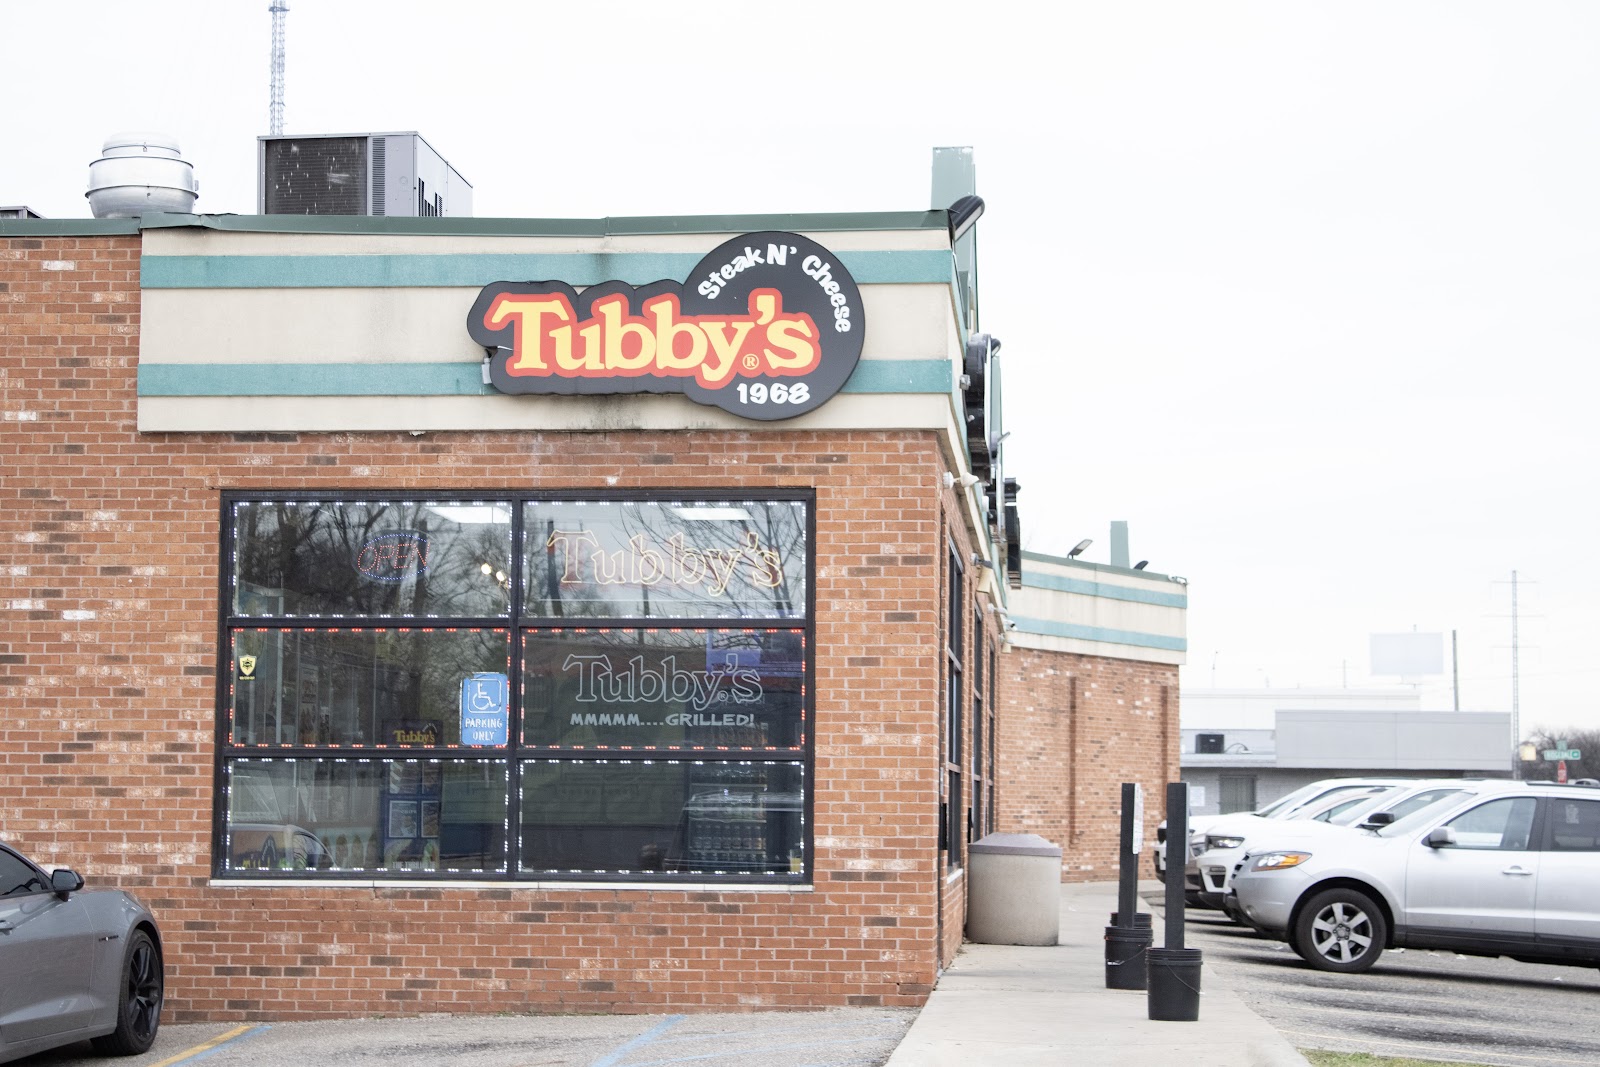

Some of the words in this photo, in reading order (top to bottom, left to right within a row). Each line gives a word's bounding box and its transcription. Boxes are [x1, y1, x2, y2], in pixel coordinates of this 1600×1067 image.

[697, 246, 765, 300] Steak
[766, 243, 797, 266] N'
[801, 254, 852, 333] Cheese
[490, 293, 816, 383] Tubby's
[736, 381, 811, 405] 1968
[357, 541, 431, 572] OPEN
[546, 529, 783, 597] Tubby's
[562, 653, 764, 711] Tubby's
[392, 729, 436, 745] Tubby's
[464, 717, 504, 729] PARKING
[472, 731, 495, 742] ONLY
